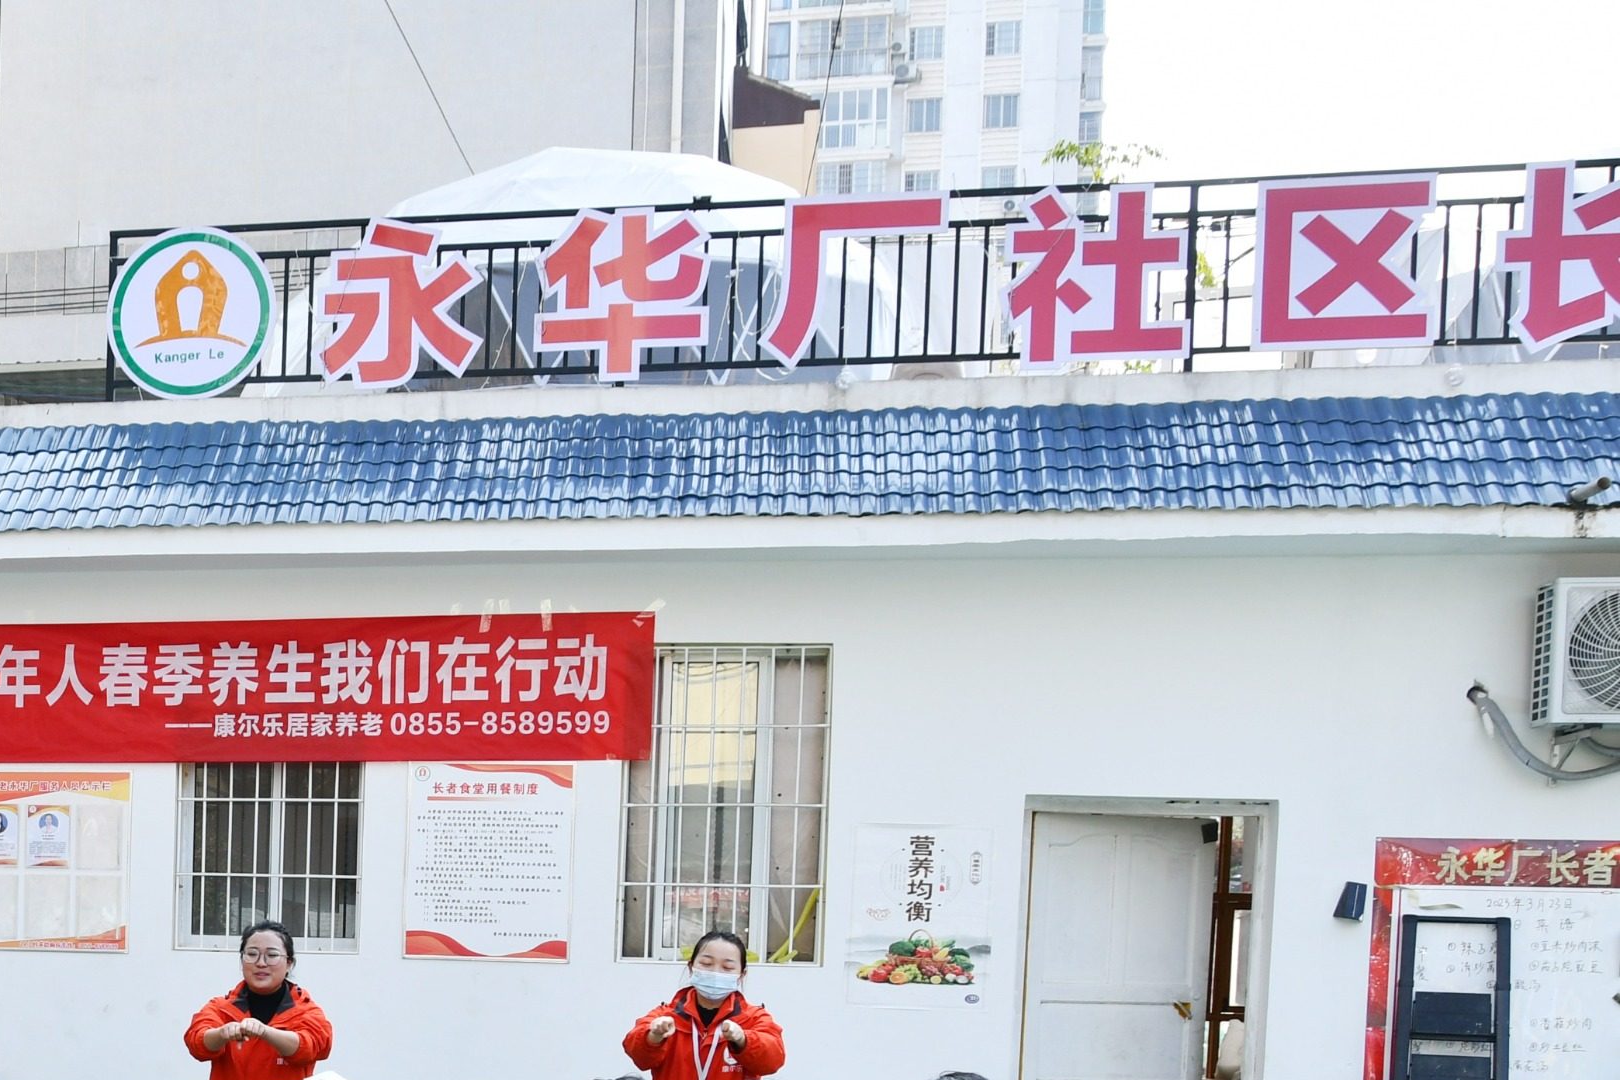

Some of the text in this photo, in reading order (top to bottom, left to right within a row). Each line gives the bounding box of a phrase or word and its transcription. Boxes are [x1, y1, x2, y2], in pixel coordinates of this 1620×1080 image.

[154, 348, 224, 364] Kanger Le
[389, 709, 611, 737] 0855-8589599
[432, 782, 539, 796] 长者食堂用餐制度
[905, 835, 936, 923] 营养均衡
